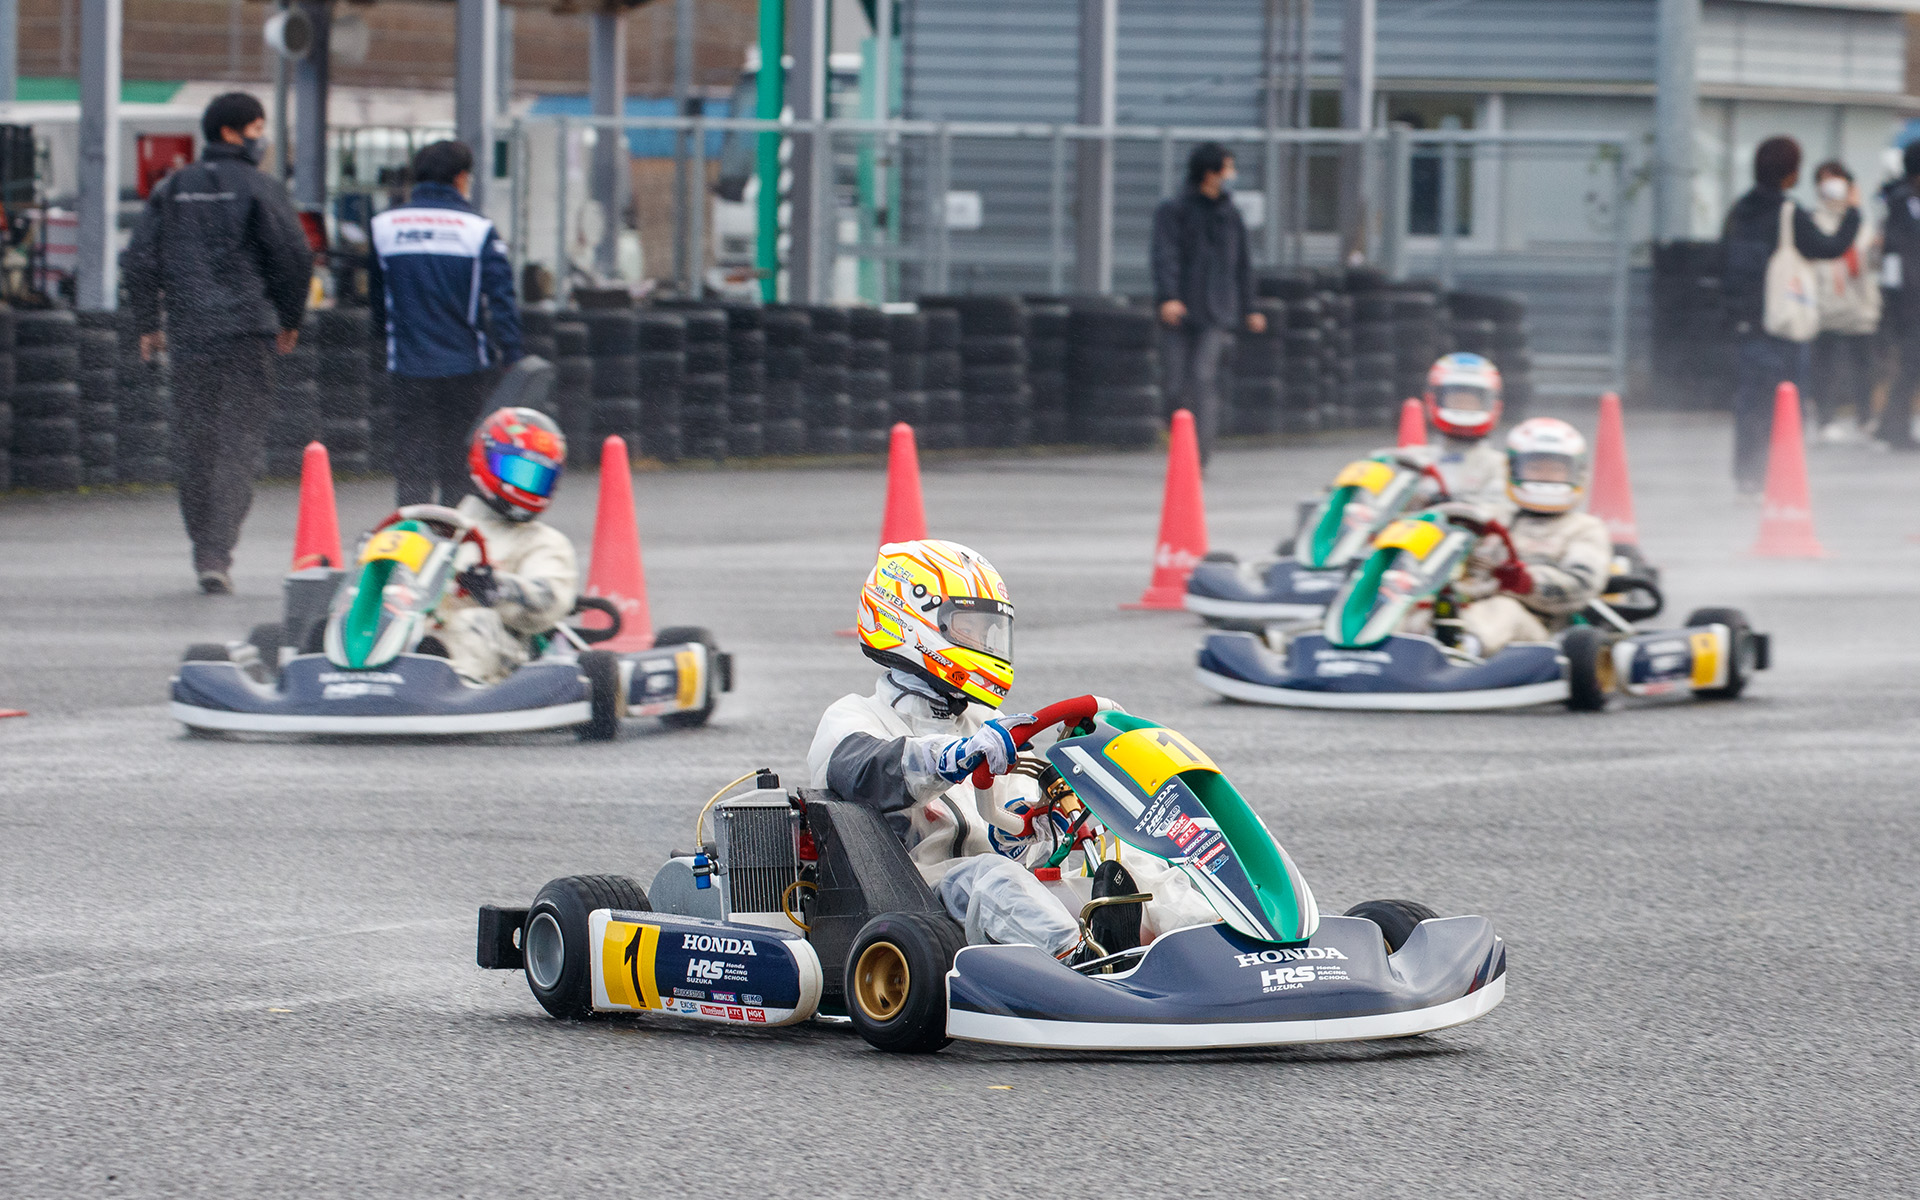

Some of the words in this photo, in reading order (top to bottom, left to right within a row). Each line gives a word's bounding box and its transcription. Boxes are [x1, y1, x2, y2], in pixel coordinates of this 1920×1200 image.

[1156, 731, 1202, 764] 1
[1134, 783, 1178, 832] HONDA
[1145, 804, 1166, 835] HRS
[1168, 815, 1187, 837] NGK
[1178, 825, 1196, 844] KTC
[682, 934, 757, 956] HONDA
[623, 927, 646, 1007] 1
[1234, 947, 1349, 968] HONDA
[686, 958, 725, 979] HRS
[1261, 966, 1316, 987] HRS
[686, 976, 713, 985] SUZUKA
[1262, 982, 1304, 993] SUZUKA
[747, 1010, 763, 1018] NGK
